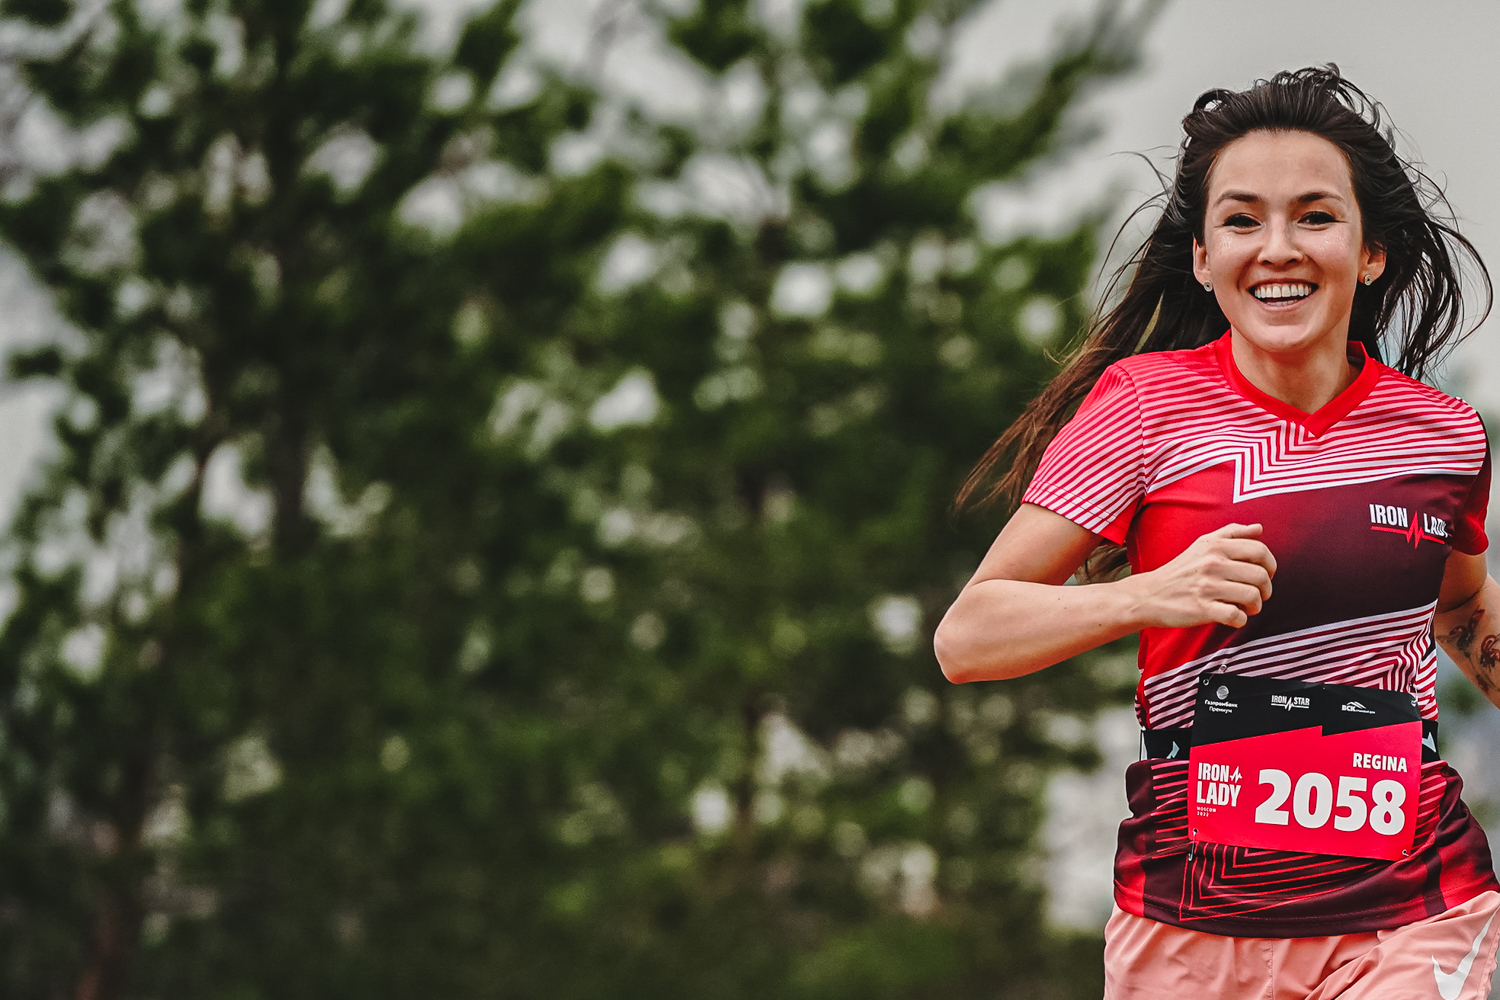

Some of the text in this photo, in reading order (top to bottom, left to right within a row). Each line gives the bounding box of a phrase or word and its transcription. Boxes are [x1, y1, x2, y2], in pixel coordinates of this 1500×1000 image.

[1369, 504, 1408, 528] IRON
[1271, 694, 1310, 706] IRON STAR
[1198, 762, 1230, 783] IRON
[1352, 752, 1408, 773] REGINA
[1196, 780, 1242, 807] LADY
[1254, 769, 1407, 836] 2058
